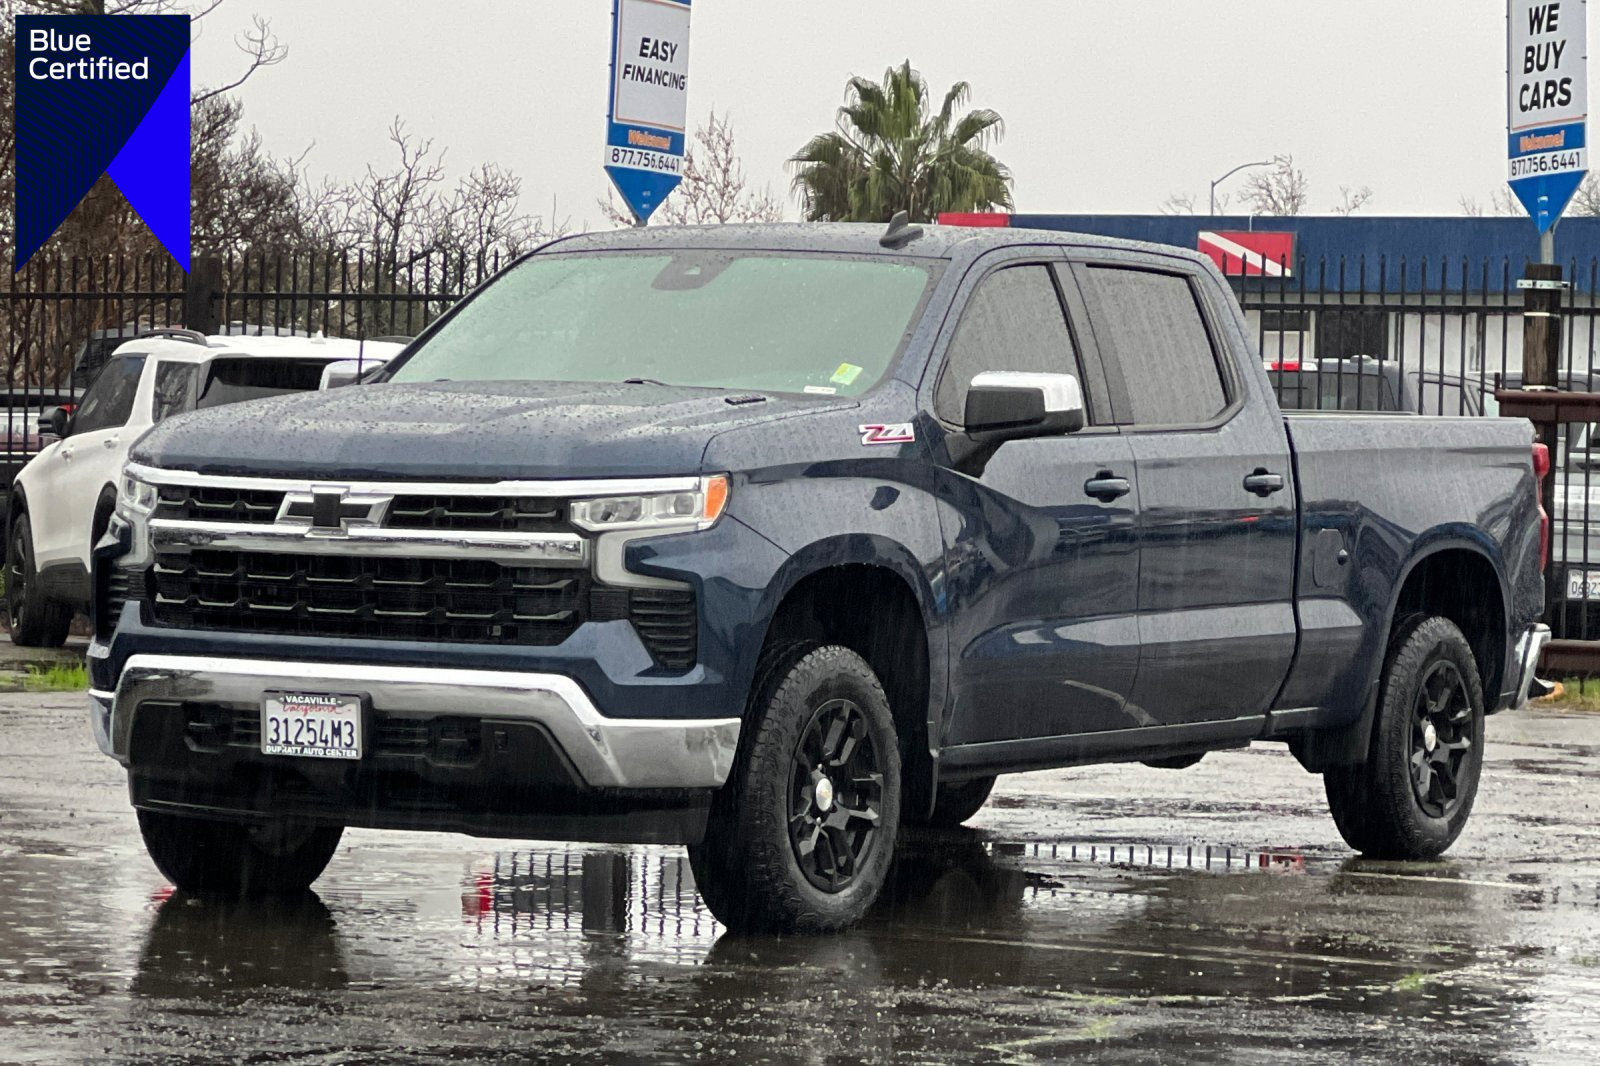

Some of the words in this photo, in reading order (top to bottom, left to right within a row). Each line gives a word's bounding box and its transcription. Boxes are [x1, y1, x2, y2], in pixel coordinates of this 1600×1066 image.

[1528, 3, 1560, 36] WE
[638, 37, 678, 64] EASY
[1523, 39, 1567, 75] BUY
[622, 64, 686, 91] FINANCING
[1519, 77, 1573, 113] CARS
[611, 147, 680, 173] 877.756.6441
[1511, 151, 1580, 177] 877.756.6441
[285, 695, 337, 705] VACAVILLE
[269, 717, 355, 748] 31254M3
[303, 747, 324, 756] AUTO
[326, 748, 357, 757] CENTER
